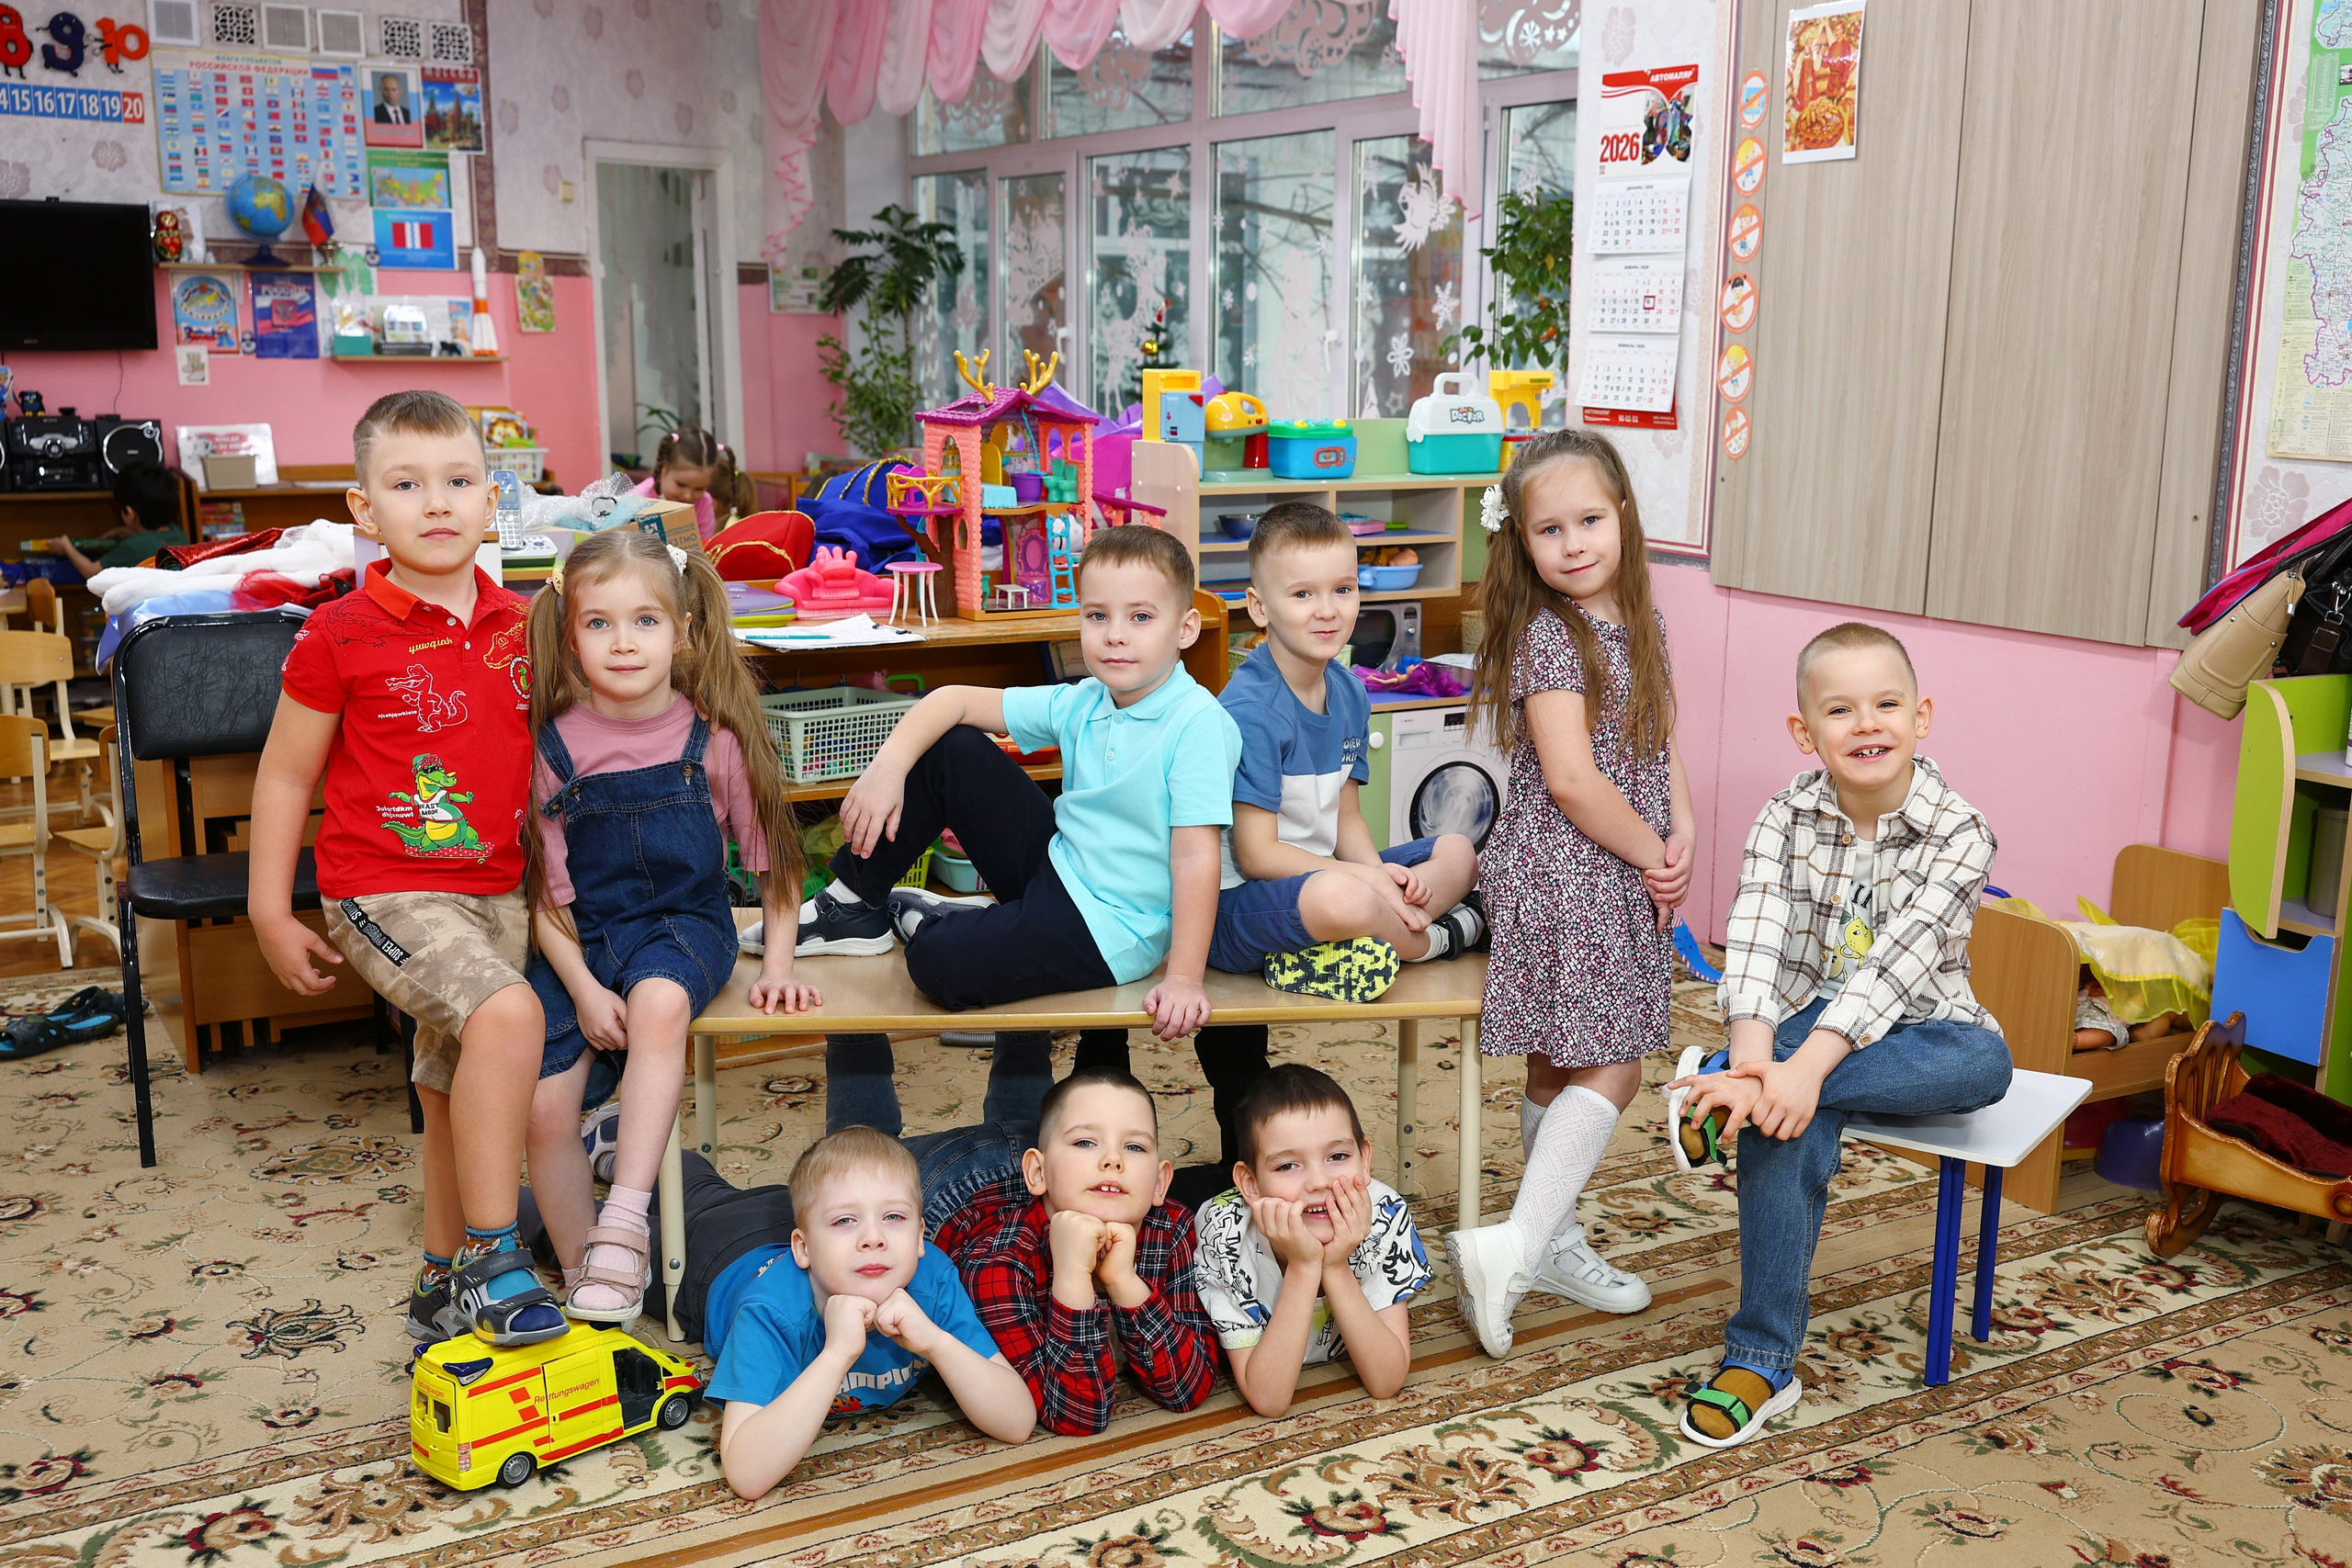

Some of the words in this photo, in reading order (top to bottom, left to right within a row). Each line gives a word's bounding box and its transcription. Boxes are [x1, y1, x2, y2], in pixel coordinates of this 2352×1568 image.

[41, 12, 85, 72] 9
[96, 17, 150, 64] 10
[189, 61, 251, 73] РОССИЙСКОЙ
[254, 66, 310, 75] ФЕДЕРАЦИИ
[1650, 70, 1693, 83] АВТОМАЛЯР
[0, 87, 8, 110] 4
[11, 89, 31, 112] 15
[35, 90, 55, 113] 16
[57, 92, 76, 115] 17
[79, 94, 100, 117] 18
[101, 96, 121, 118] 19
[123, 96, 143, 119] 20
[1600, 132, 1640, 163] 2026
[680, 533, 697, 544] ГМО
[534, 1378, 600, 1404] Rettungswagen
